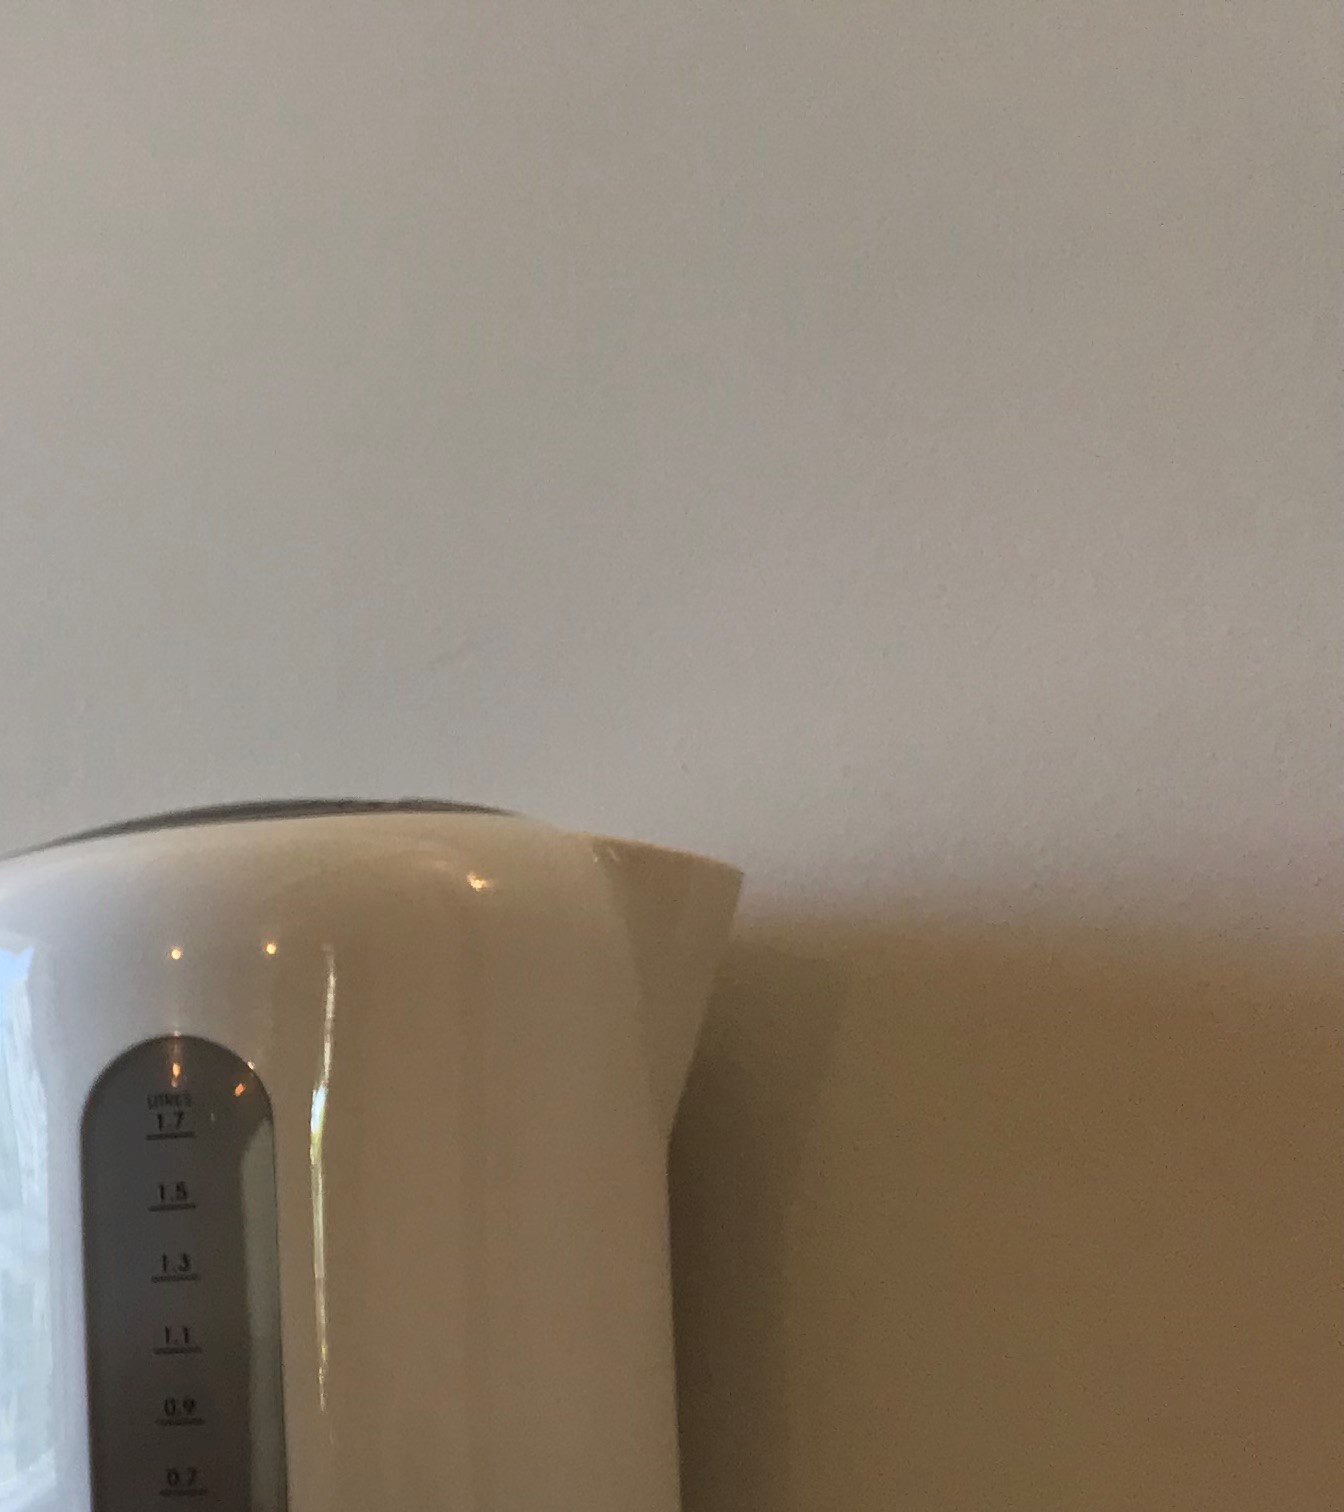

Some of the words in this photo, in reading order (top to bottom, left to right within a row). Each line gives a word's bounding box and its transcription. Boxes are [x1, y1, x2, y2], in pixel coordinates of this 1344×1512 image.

[157, 1110, 185, 1131] 1.7
[159, 1181, 188, 1202] 1.5
[161, 1252, 191, 1273] 1.3
[164, 1325, 190, 1345] 1.1
